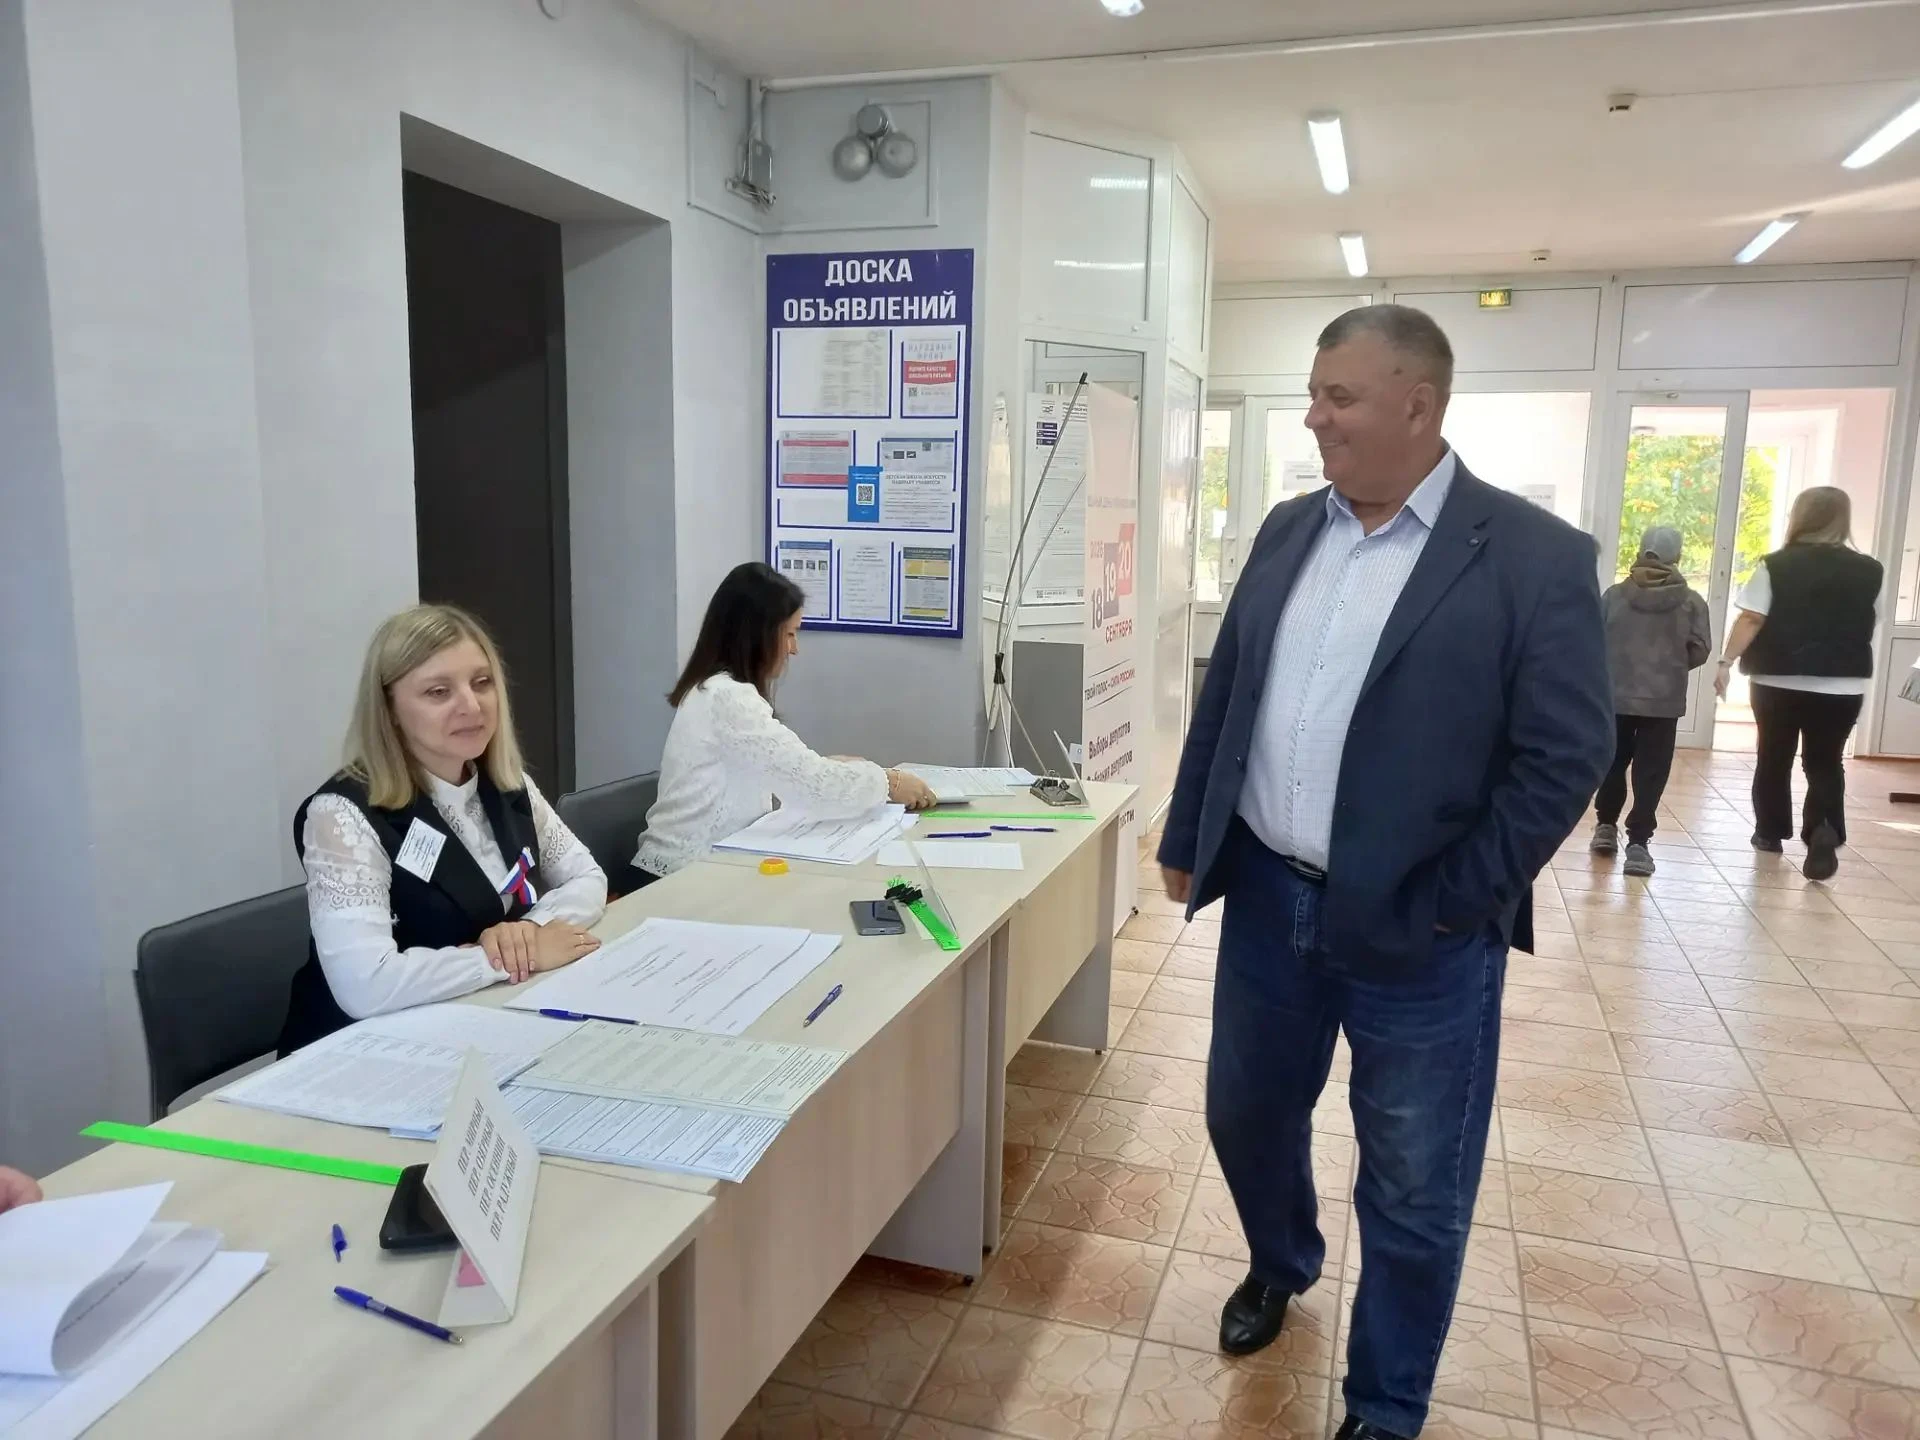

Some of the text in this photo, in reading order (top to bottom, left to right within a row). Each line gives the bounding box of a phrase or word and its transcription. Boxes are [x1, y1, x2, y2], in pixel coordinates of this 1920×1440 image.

[825, 258, 912, 286] ДОСКА
[783, 290, 957, 322] ОБЪЯВЛЕНИЙ
[1118, 541, 1132, 580] 20
[1104, 562, 1117, 602] 19
[1092, 587, 1103, 630] 18
[1105, 620, 1133, 644] СЕНТЯБРЯ
[1089, 721, 1130, 760] Выборы депутатов
[1110, 750, 1132, 776] депутатов
[458, 1096, 484, 1175] ПЕР. МИРНЫЙ
[468, 1166, 481, 1197] ПЕР.
[480, 1133, 506, 1217] ПЕР. ОСЕННИЙ
[490, 1146, 518, 1241] ПЕР. РАДУЖНЫЙ
